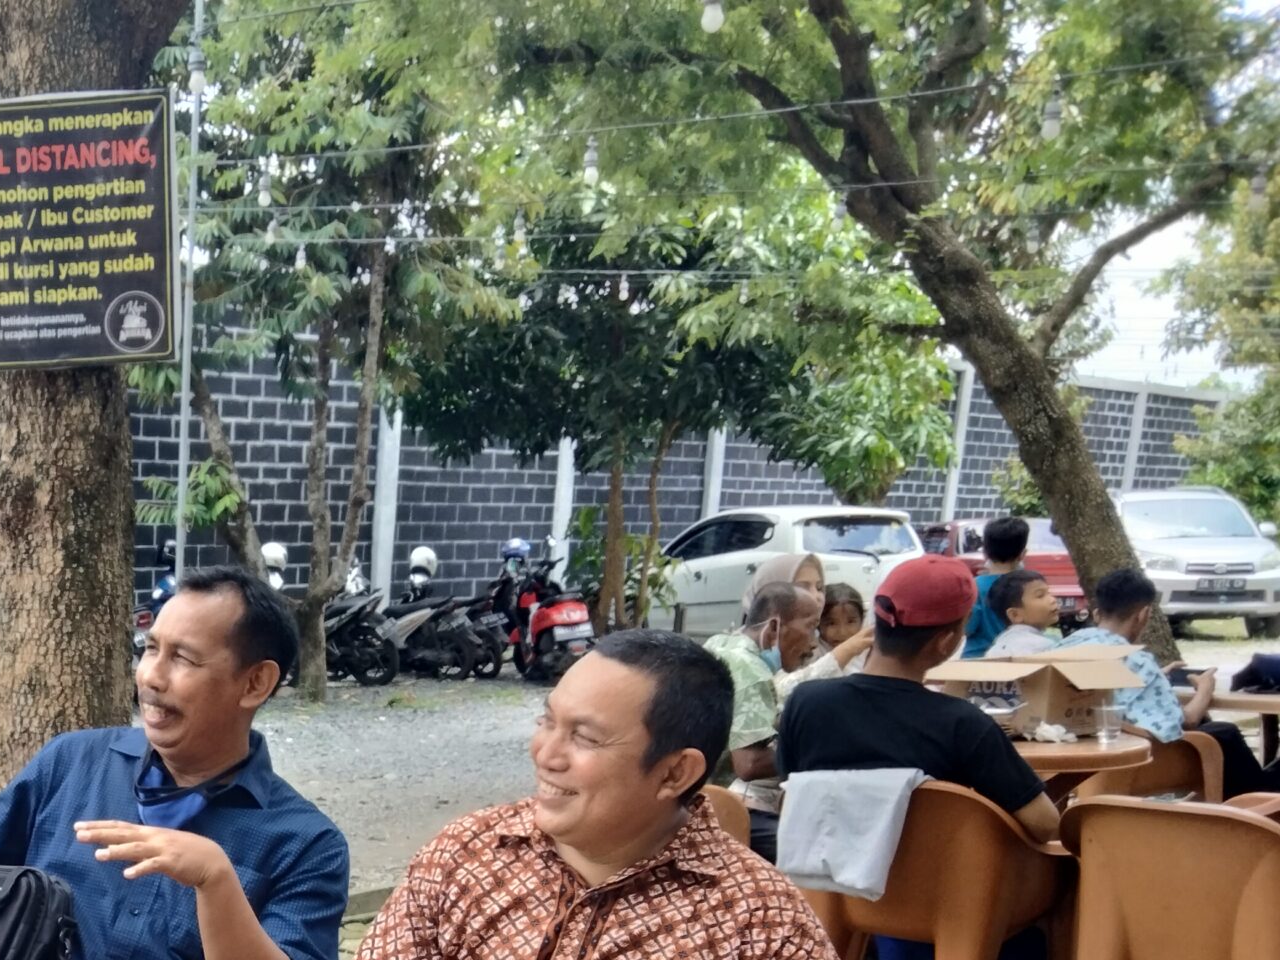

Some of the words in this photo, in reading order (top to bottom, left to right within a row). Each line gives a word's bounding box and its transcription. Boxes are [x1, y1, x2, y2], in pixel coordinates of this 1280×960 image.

[48, 108, 154, 131] menerapkan
[16, 137, 156, 173] DISTANCING,
[53, 178, 146, 202] pengertian
[41, 208, 68, 226] Ibu
[72, 203, 154, 224] Customer
[20, 234, 84, 254] Arwana
[88, 229, 137, 249] untuk
[14, 261, 54, 280] kursi
[58, 262, 99, 280] yang
[104, 253, 154, 274] sudah
[34, 285, 103, 305] siapkan.
